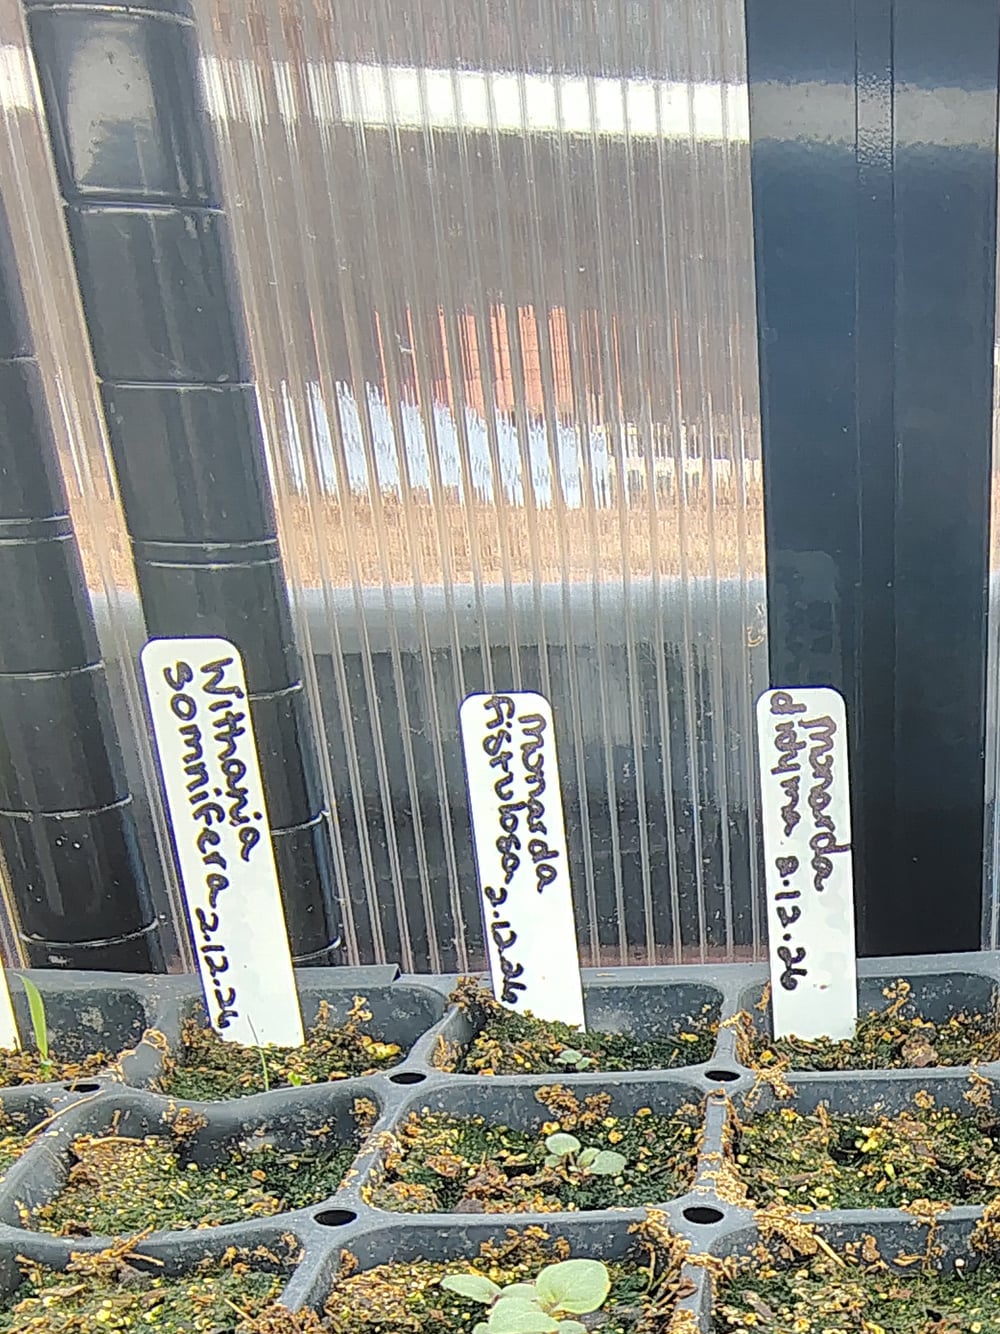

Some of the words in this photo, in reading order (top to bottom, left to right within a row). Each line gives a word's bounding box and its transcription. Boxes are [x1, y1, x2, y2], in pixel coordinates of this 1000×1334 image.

[199, 656, 262, 863] Withania
[195, 907, 239, 1029] 2.12.26
[484, 885, 527, 1005] 2.12.26
[775, 855, 808, 992] 2.12.26
